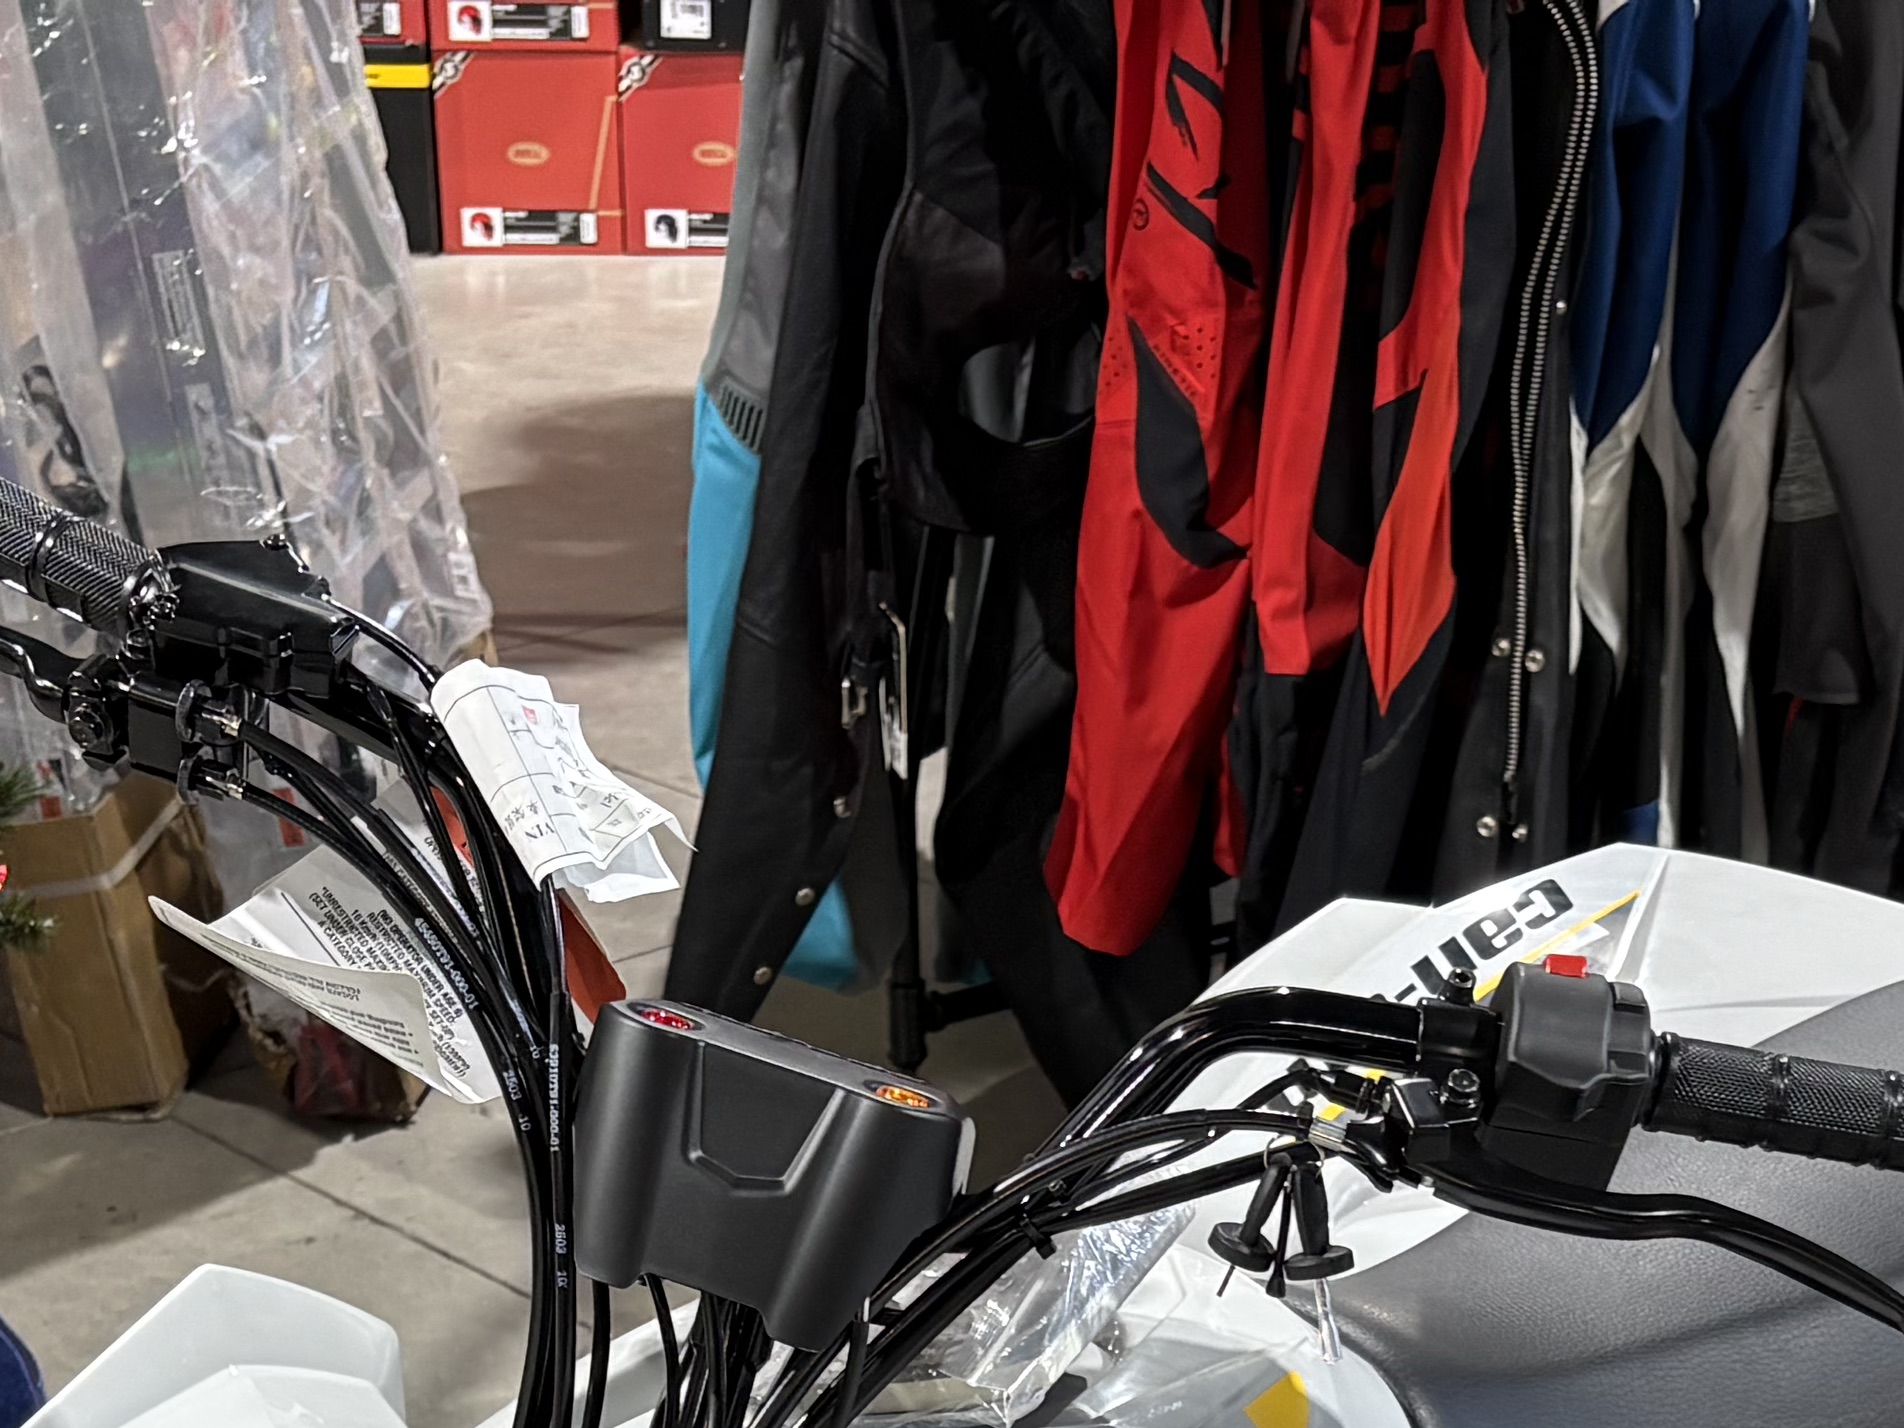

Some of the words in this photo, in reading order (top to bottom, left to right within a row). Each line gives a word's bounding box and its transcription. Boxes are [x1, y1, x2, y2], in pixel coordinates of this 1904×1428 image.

[524, 822, 554, 839] VIN
[366, 912, 406, 960] RESTRICTED
[388, 924, 424, 965] OPERATOR
[420, 963, 445, 992] UNDER
[1394, 879, 1573, 1003] can-
